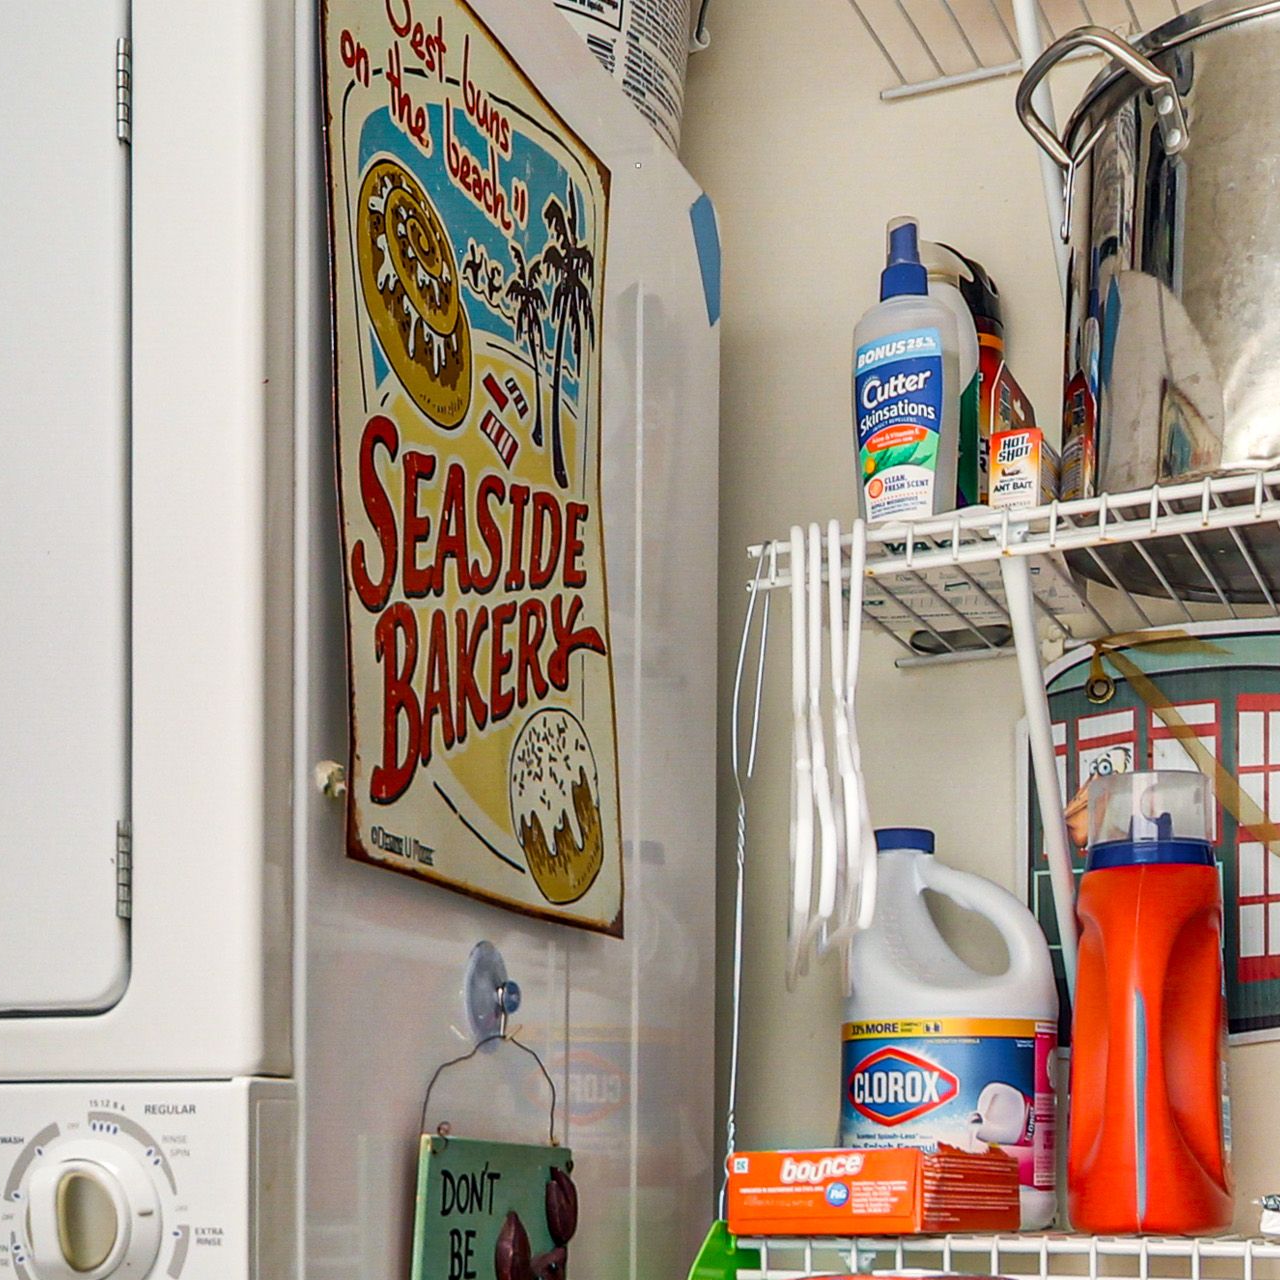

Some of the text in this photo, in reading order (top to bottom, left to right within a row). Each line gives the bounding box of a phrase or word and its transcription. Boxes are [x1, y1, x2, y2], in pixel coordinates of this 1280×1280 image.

[340, 29, 369, 88] on
[386, 40, 430, 149] the
[463, 34, 510, 153] buns
[857, 339, 906, 368] BONUS
[863, 370, 932, 409] Cutter
[860, 399, 936, 437] Skinsations
[998, 446, 1032, 462] SHOT
[1002, 435, 1027, 450] HOT
[884, 479, 929, 493] FRESH SCENT
[993, 481, 1033, 493] ANT BAIT
[352, 415, 588, 613] SEASIDE
[371, 594, 606, 805] BAKERY
[865, 1022, 899, 1034] MORE
[854, 1070, 940, 1104] CLOROX
[145, 1104, 196, 1115] REGULAR
[781, 1155, 863, 1183] bounce
[440, 1162, 502, 1217] DON'T
[195, 1228, 224, 1236] EXTRA
[196, 1238, 222, 1246] RINSE
